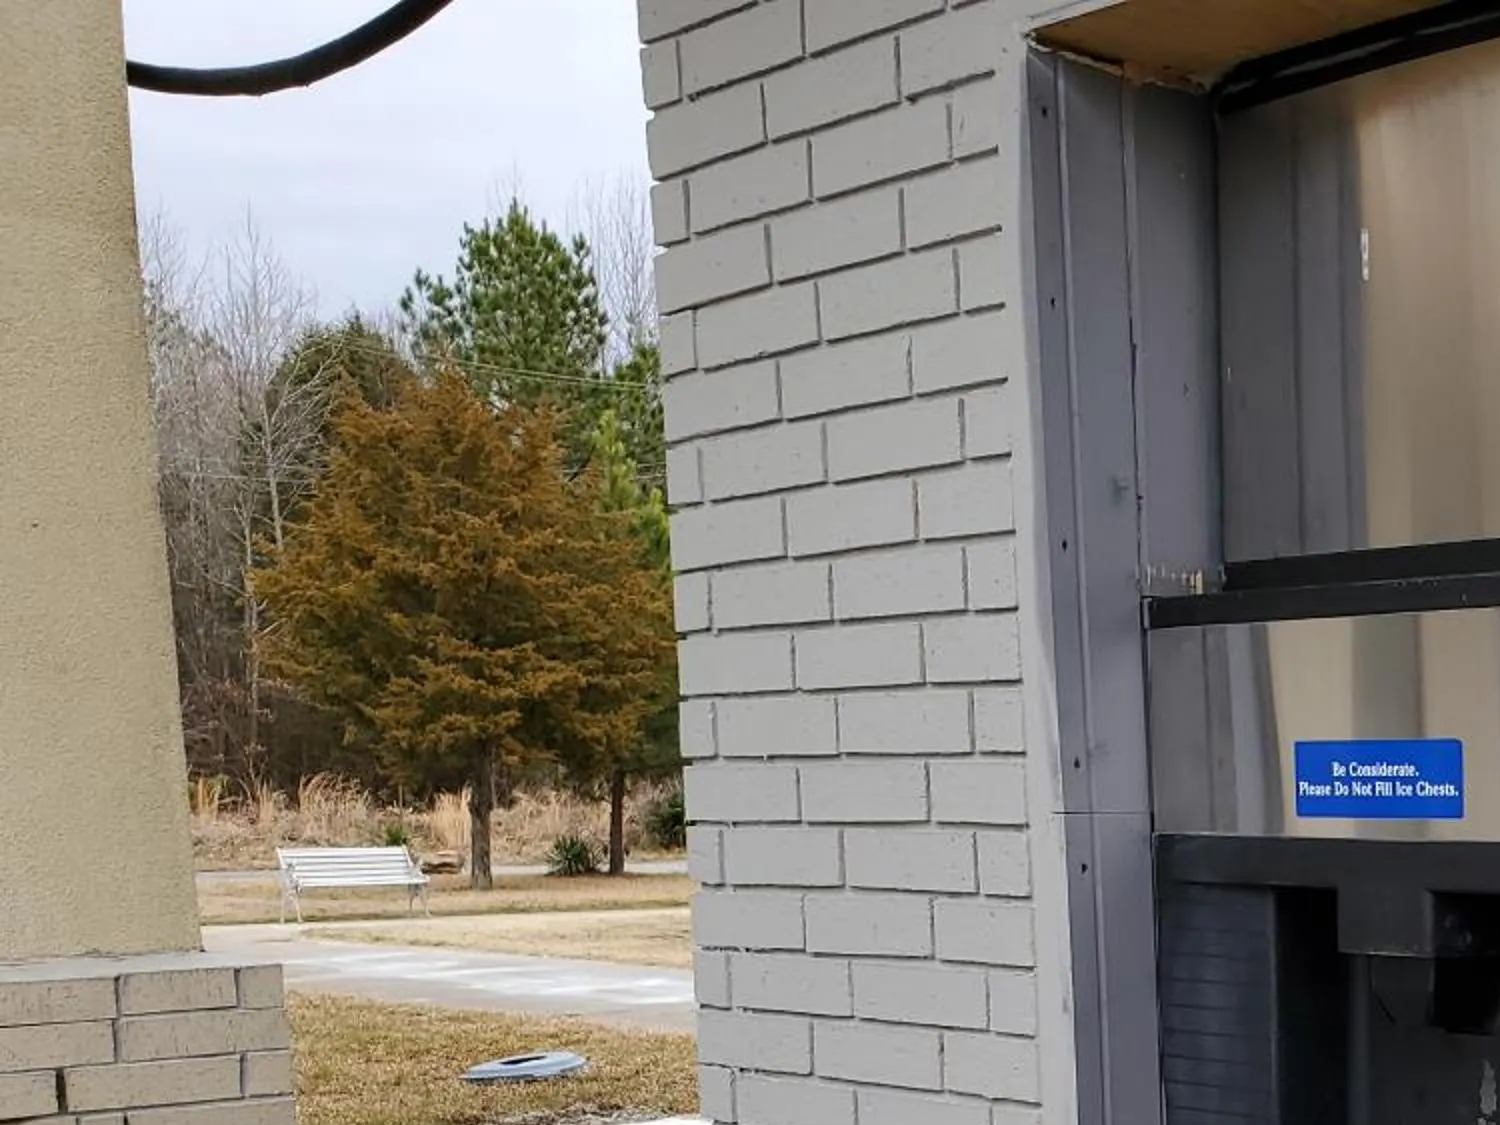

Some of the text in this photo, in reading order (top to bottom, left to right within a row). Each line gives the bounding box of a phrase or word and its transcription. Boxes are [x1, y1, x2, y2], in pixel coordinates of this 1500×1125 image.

[1331, 761, 1420, 777] Be Considerate.
[1298, 780, 1459, 797] Please Do Not Fill Ice Chests.
